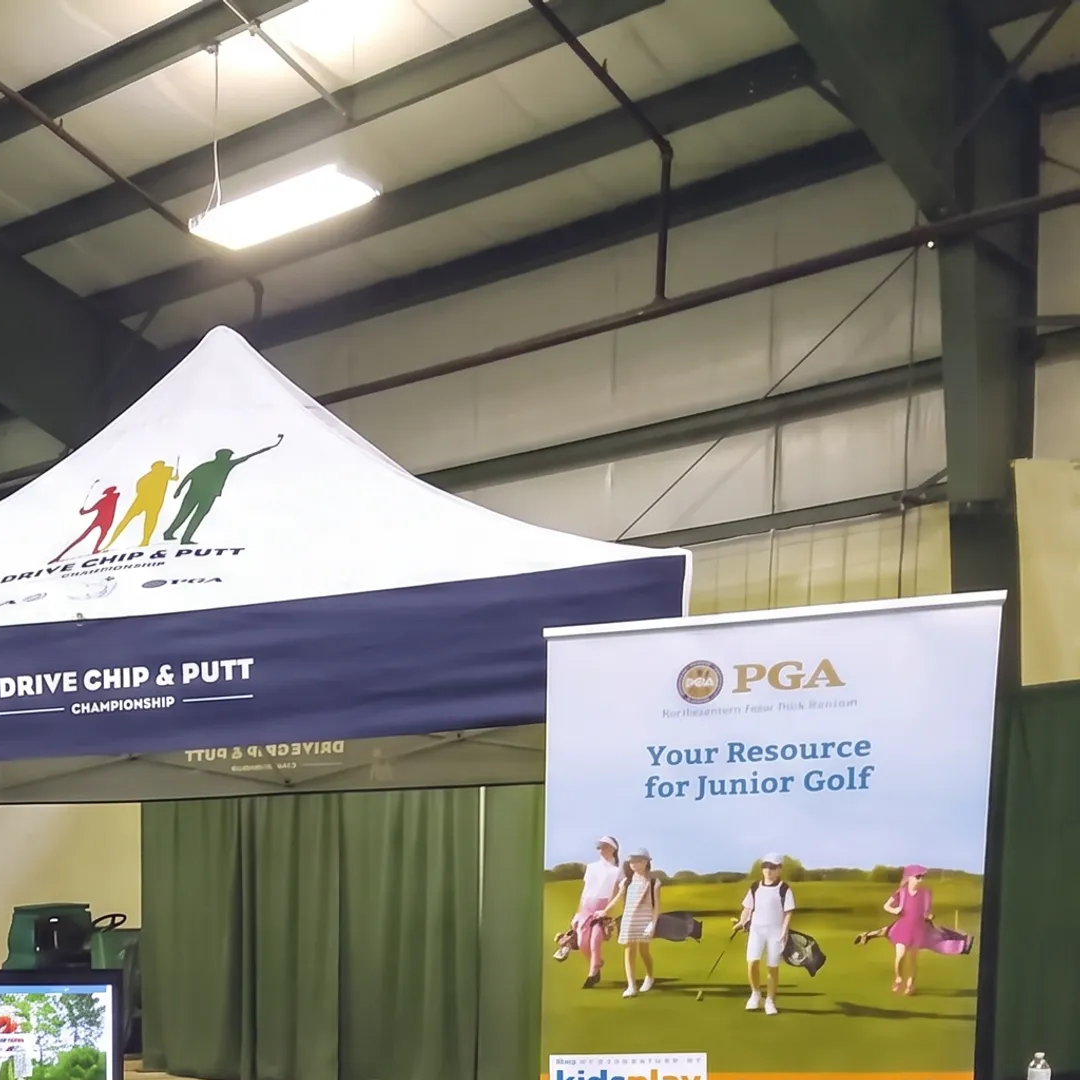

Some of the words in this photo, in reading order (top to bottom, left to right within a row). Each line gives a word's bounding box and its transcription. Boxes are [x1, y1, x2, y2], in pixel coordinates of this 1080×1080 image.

[0, 563, 77, 584] DRIVE
[81, 551, 144, 568] CHIP
[149, 550, 167, 559] &
[175, 547, 246, 558] PUTT
[0, 671, 78, 699] DRIVE
[83, 666, 150, 691] CHIP
[155, 664, 175, 686] &
[182, 658, 254, 684] PUTT
[731, 658, 846, 694] PGA
[71, 696, 176, 715] CHAMPIONSHIP
[646, 745, 719, 767] Your
[726, 739, 872, 764] Resource
[645, 775, 690, 799] for
[695, 771, 795, 801] Junior
[803, 765, 875, 792] Golf
